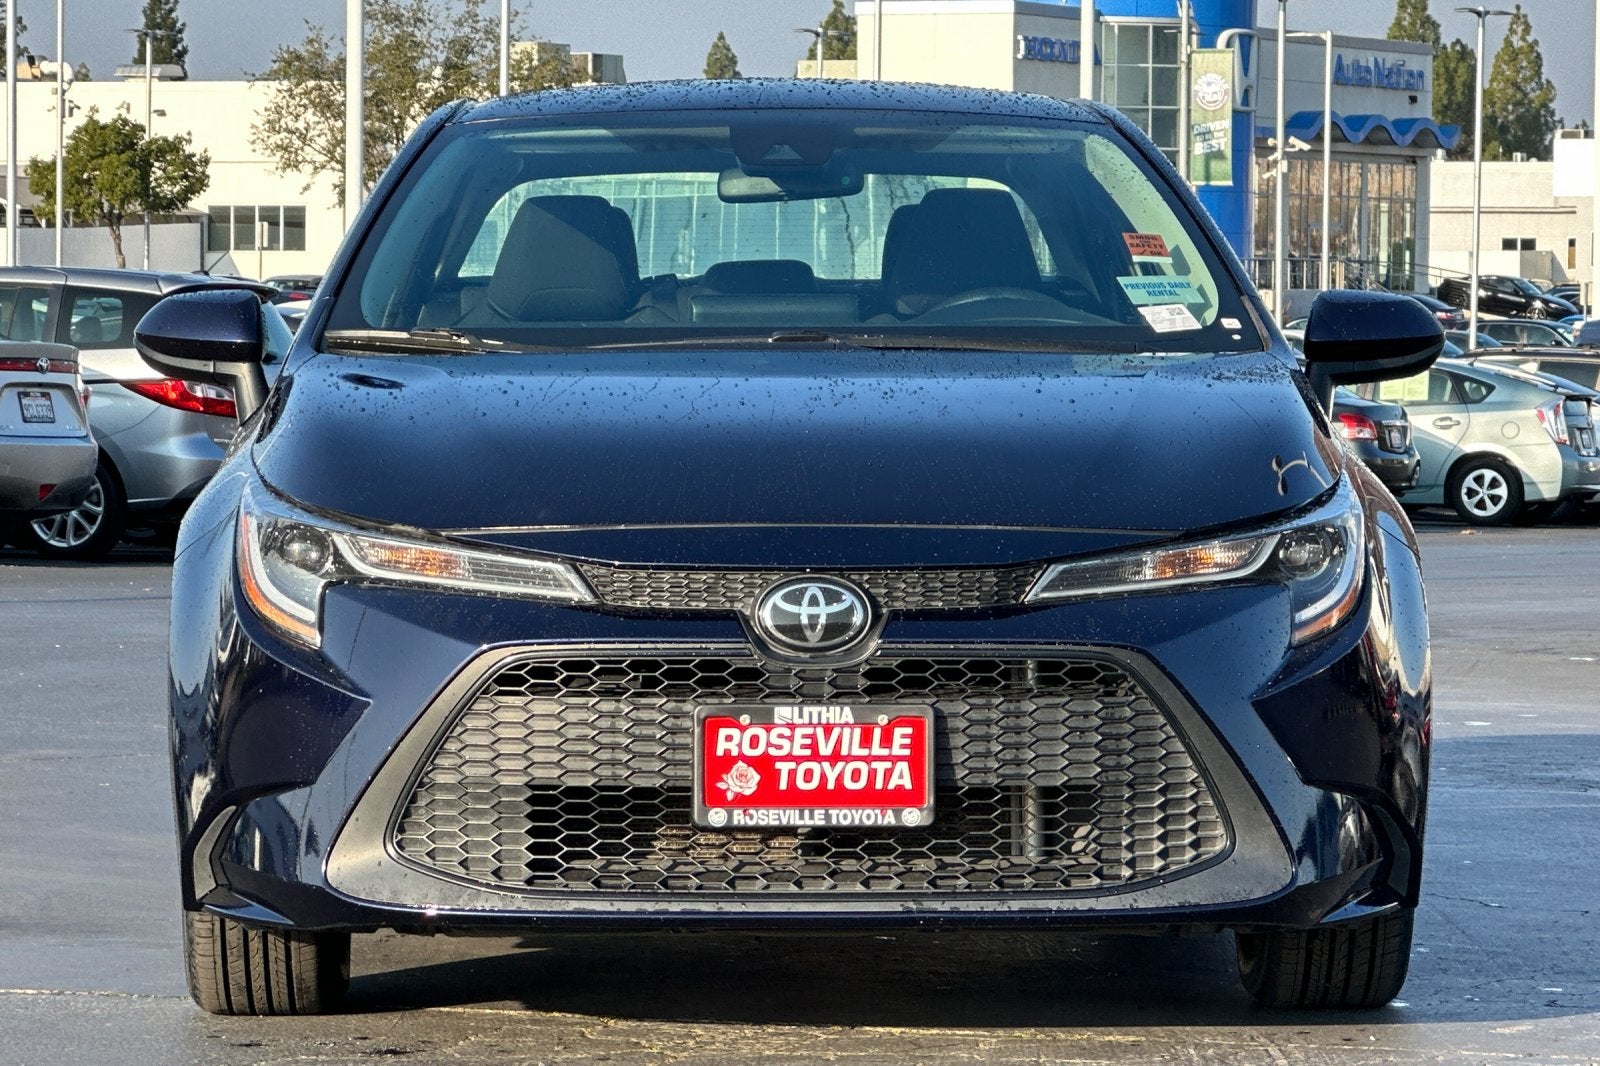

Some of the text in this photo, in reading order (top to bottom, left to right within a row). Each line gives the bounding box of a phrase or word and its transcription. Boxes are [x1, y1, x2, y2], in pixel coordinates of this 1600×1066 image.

[1334, 53, 1425, 90] AutoNation
[1193, 120, 1229, 134] DRIVEN
[1194, 137, 1228, 155] BEST
[1123, 282, 1167, 290] PREVIOUS
[793, 707, 854, 724] LITHIA
[715, 727, 913, 756] ROSEVILLE
[774, 761, 913, 790] TOYOTA
[733, 810, 896, 825] ROSEVILLE TOYOTA
